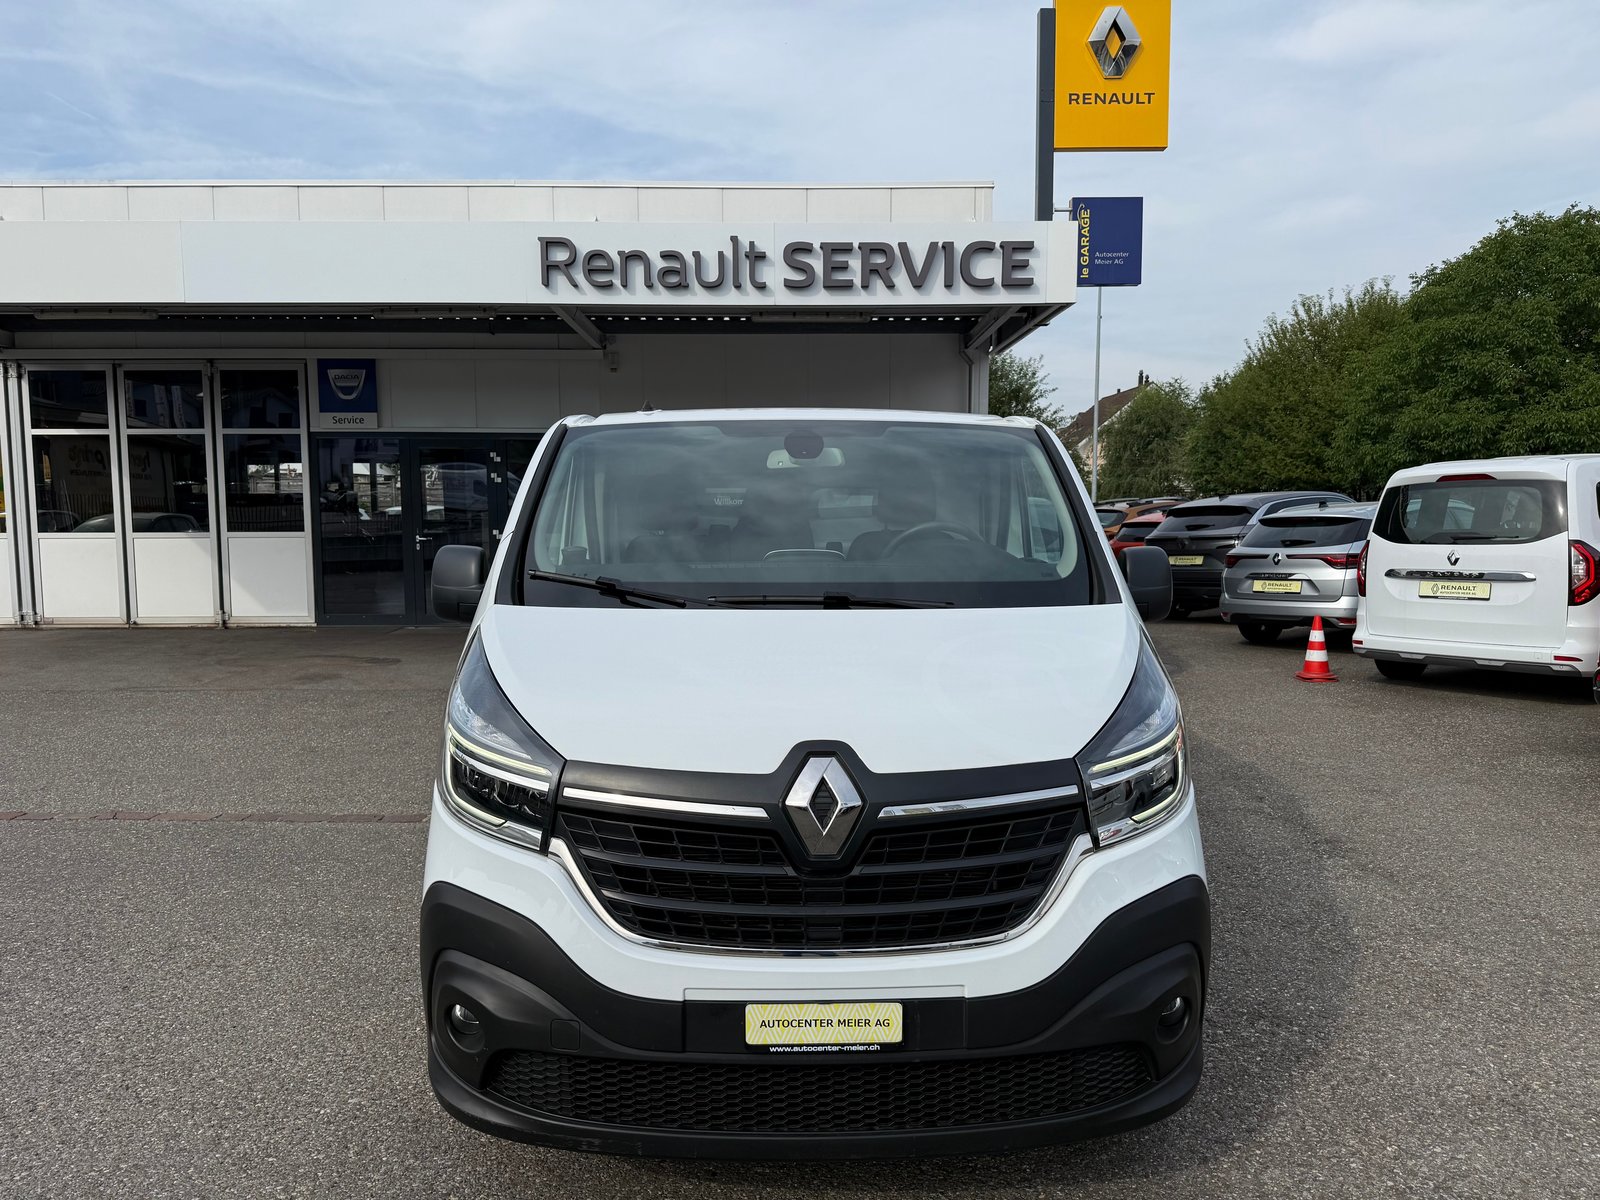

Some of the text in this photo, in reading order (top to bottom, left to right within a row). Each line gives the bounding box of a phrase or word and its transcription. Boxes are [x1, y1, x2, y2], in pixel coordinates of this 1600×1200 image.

[1069, 92, 1155, 105] RENAULT
[1080, 209, 1090, 278] le GARAGE
[537, 236, 1035, 289] Renault SERVICE
[332, 415, 365, 425] Service
[1440, 584, 1477, 592] RENAULT
[760, 1018, 891, 1029] AUTOCENTER MEIER AG
[769, 1044, 881, 1053] www.autocenter-meier.ch
